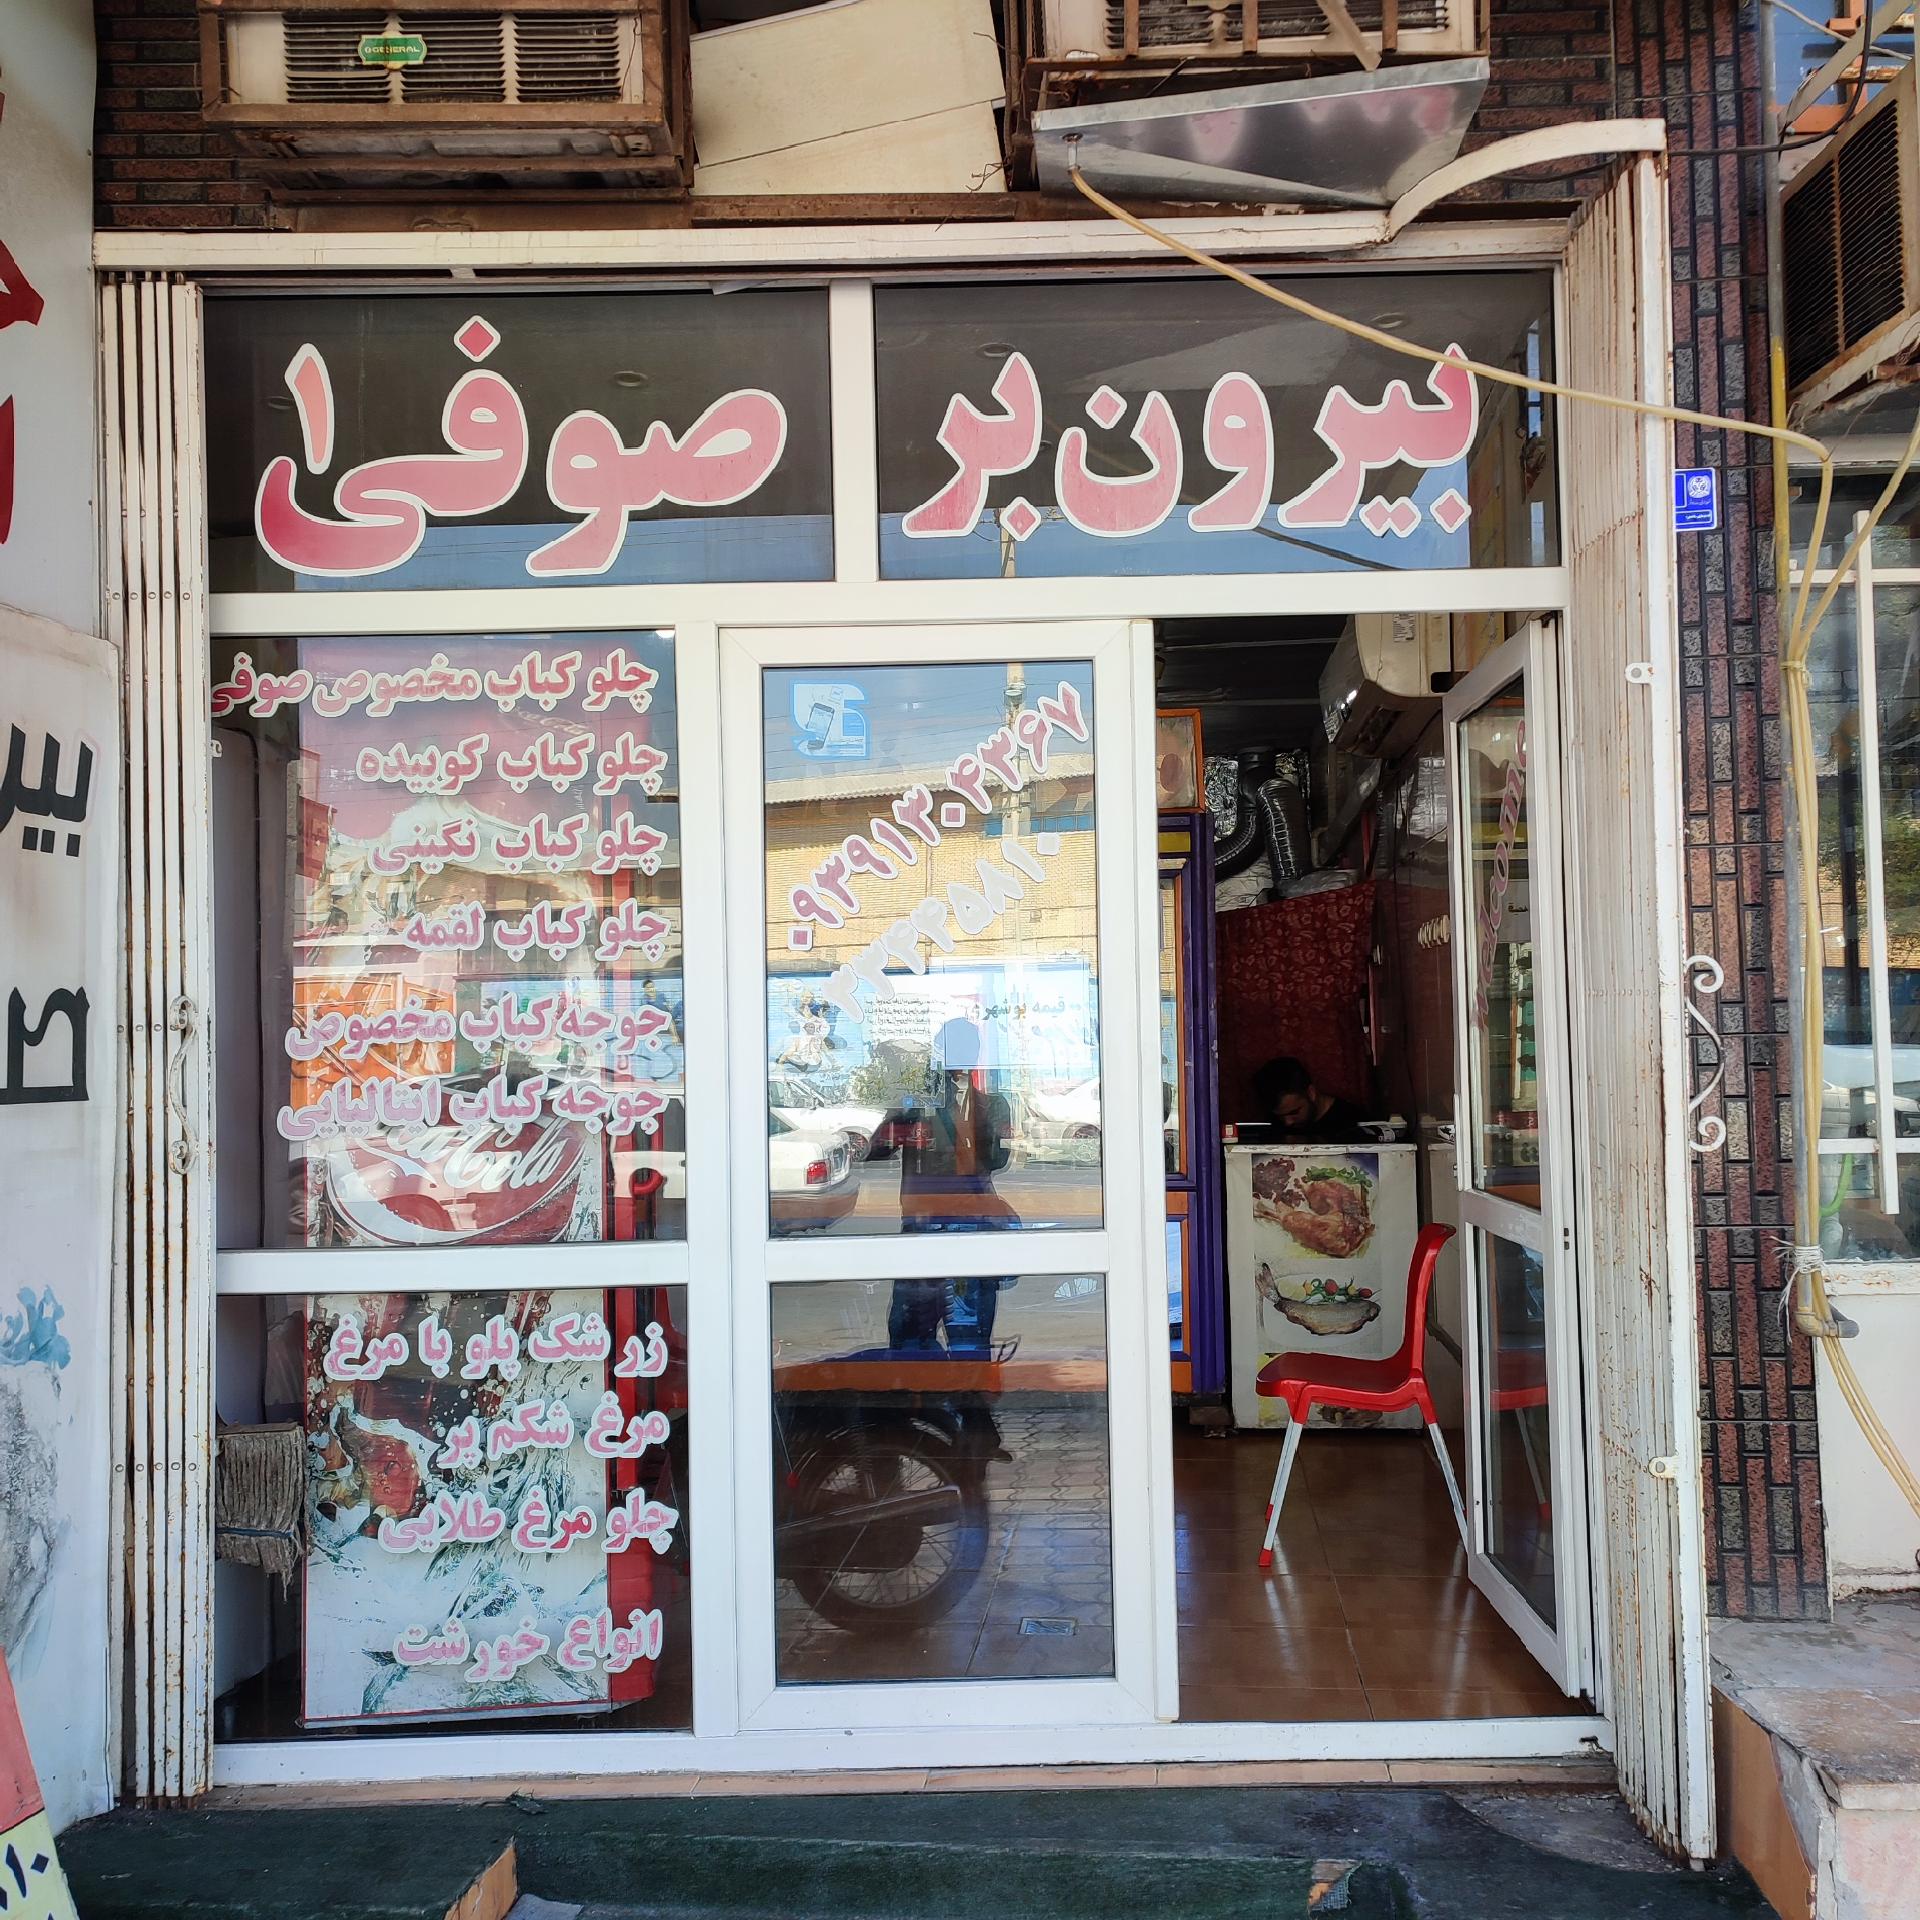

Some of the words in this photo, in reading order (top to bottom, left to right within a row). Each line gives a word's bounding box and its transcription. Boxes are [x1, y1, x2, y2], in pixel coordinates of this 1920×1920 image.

[902, 352, 1042, 541] بر
[1055, 342, 1479, 538] بیرون
[313, 653, 482, 717] مخصوص
[484, 651, 582, 713] کباب
[582, 648, 659, 713] چلو
[356, 733, 490, 795] کوبیده
[497, 733, 595, 793] کباب
[593, 732, 668, 795] چلو
[368, 811, 481, 876] نگینی
[491, 813, 589, 874] کباب
[592, 811, 668, 876] چلو
[402, 901, 486, 951] لقمه
[493, 900, 592, 961] کباب
[596, 898, 670, 962] چلو
[285, 994, 456, 1061] مخصوص
[460, 991, 557, 1054] کباب
[555, 1000, 672, 1055] جوجه
[276, 1076, 441, 1142] ایتالیایی
[449, 1073, 548, 1136] کباب
[552, 1081, 670, 1137] جوجه
[323, 1313, 409, 1381] مرغ
[418, 1315, 452, 1379] با
[460, 1315, 522, 1381] پلو
[528, 1312, 669, 1377] زرشک
[437, 1416, 481, 1468] پر
[488, 1399, 576, 1460] شکم
[584, 1390, 670, 1458] مرغ
[378, 1490, 505, 1553] طلایی
[512, 1486, 596, 1554] مرغ
[601, 1488, 679, 1554] چلو
[393, 1614, 550, 1683] خورشت
[557, 1608, 664, 1673] انواع
